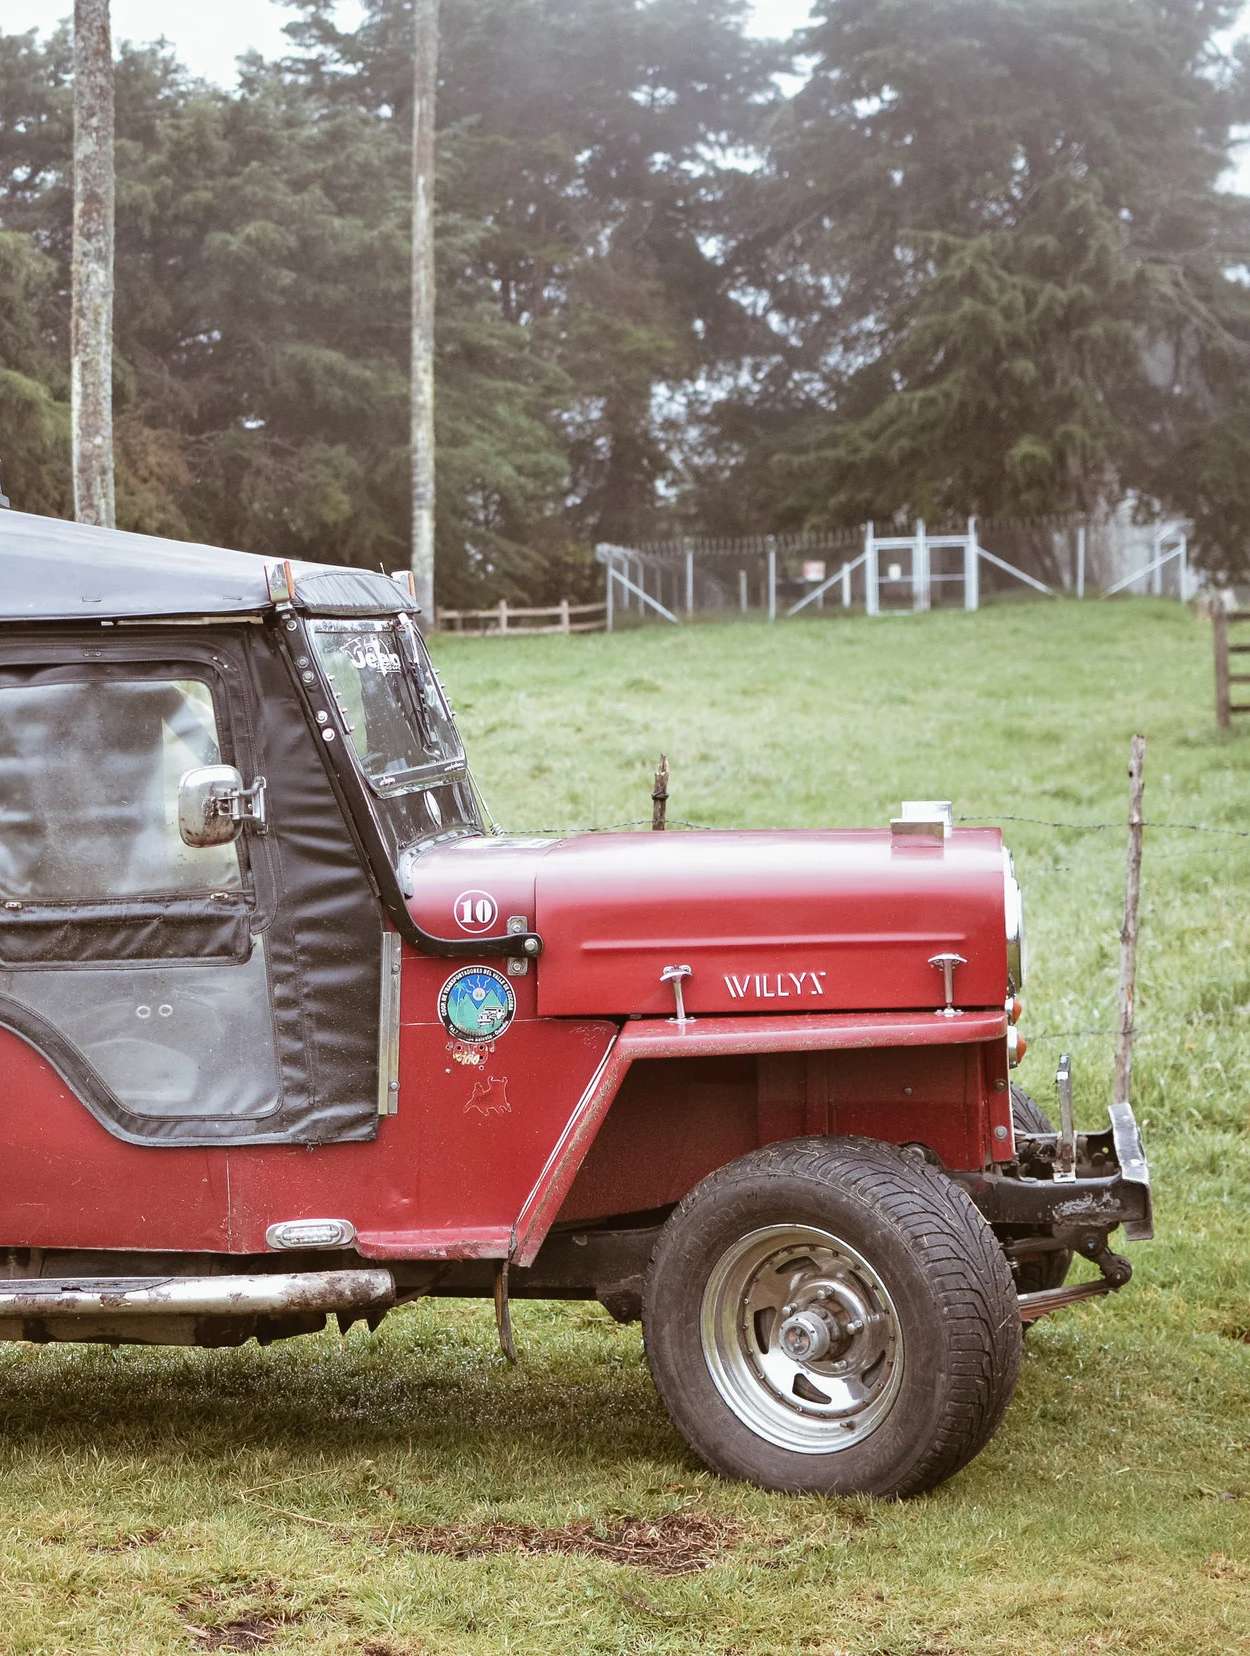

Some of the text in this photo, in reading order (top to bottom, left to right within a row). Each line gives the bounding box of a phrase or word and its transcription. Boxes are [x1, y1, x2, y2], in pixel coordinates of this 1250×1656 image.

[460, 898, 493, 924] 10
[442, 967, 482, 994] TRANSPORTADORES
[490, 971, 505, 985] VALLE
[724, 971, 827, 998] WILLYS
